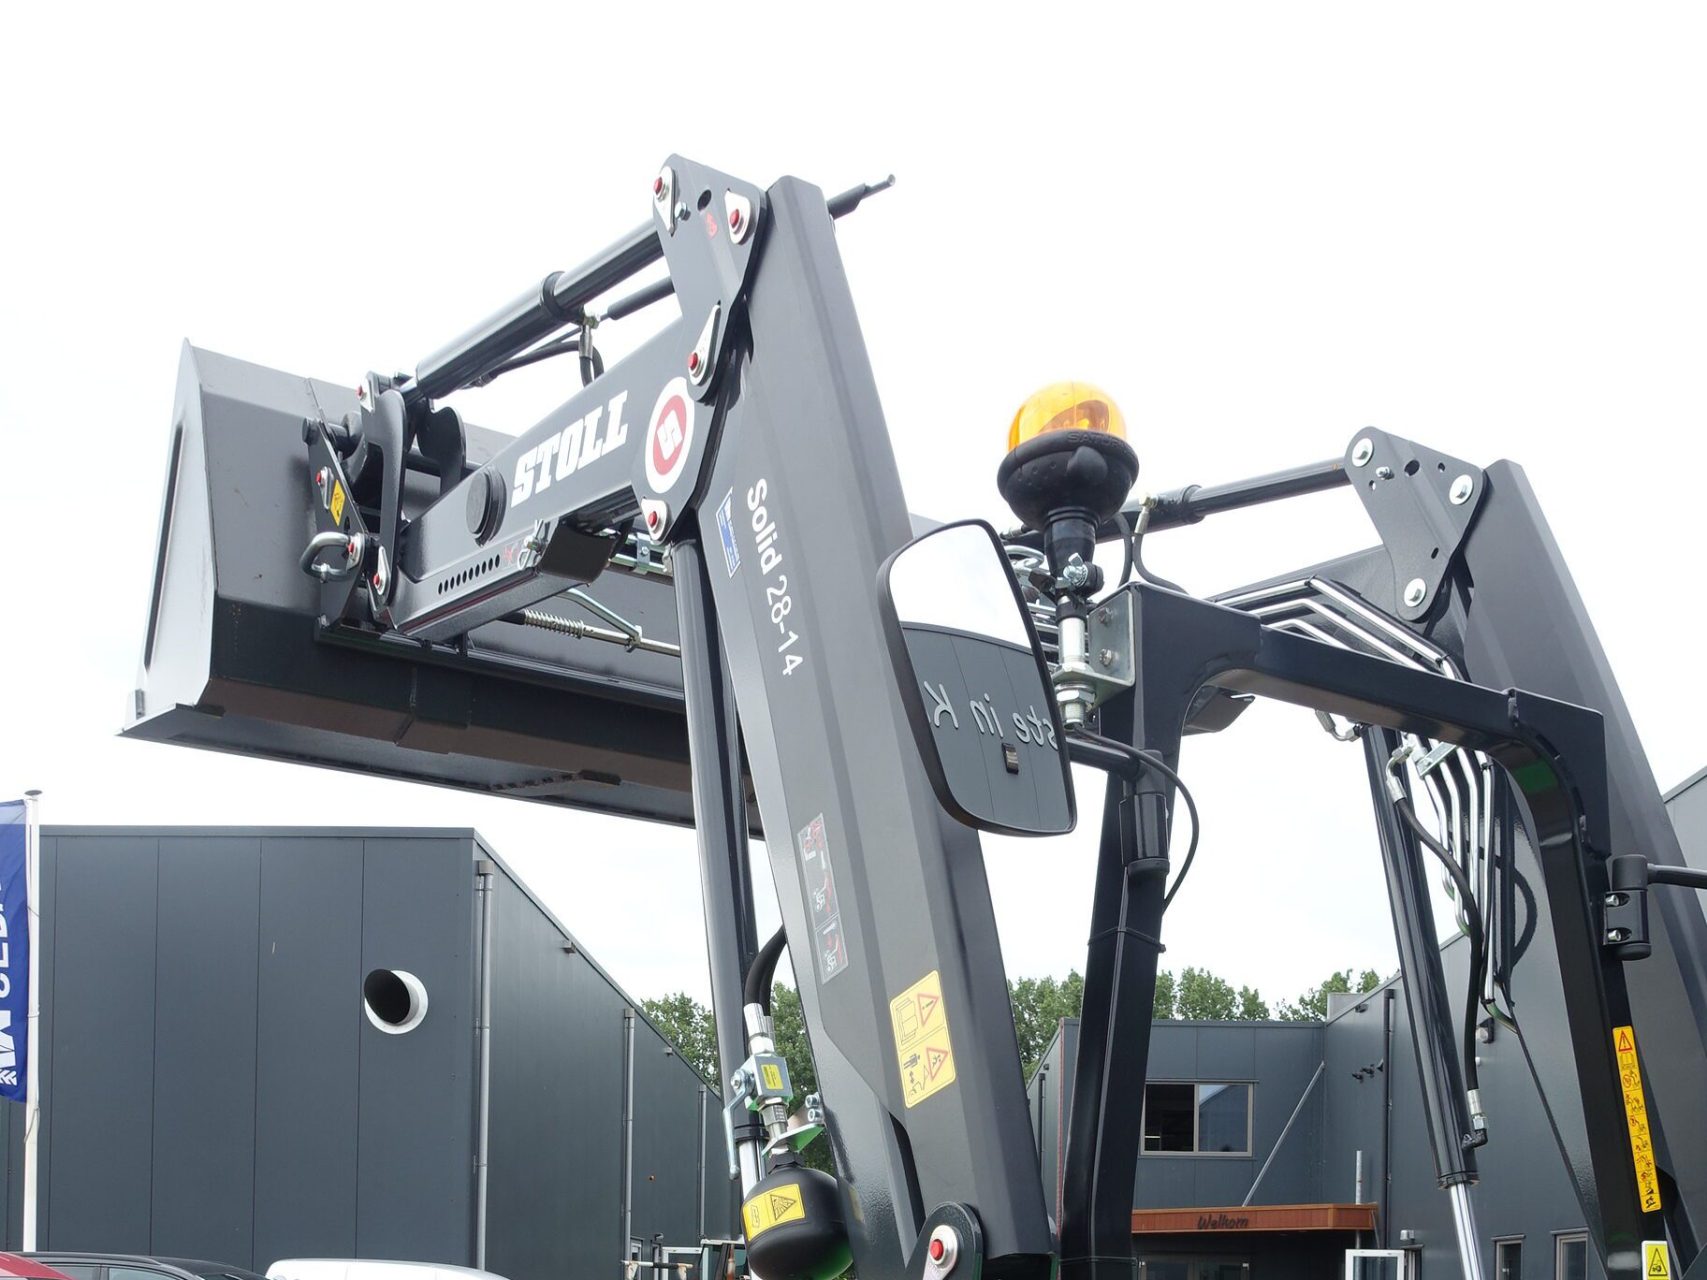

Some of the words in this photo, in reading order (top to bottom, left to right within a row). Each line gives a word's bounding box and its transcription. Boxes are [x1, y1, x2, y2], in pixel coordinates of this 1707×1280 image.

[511, 390, 628, 508] STOLL
[747, 478, 782, 575] Solid
[767, 575, 803, 675] 28-14
[1199, 1213, 1248, 1230] Welkom
